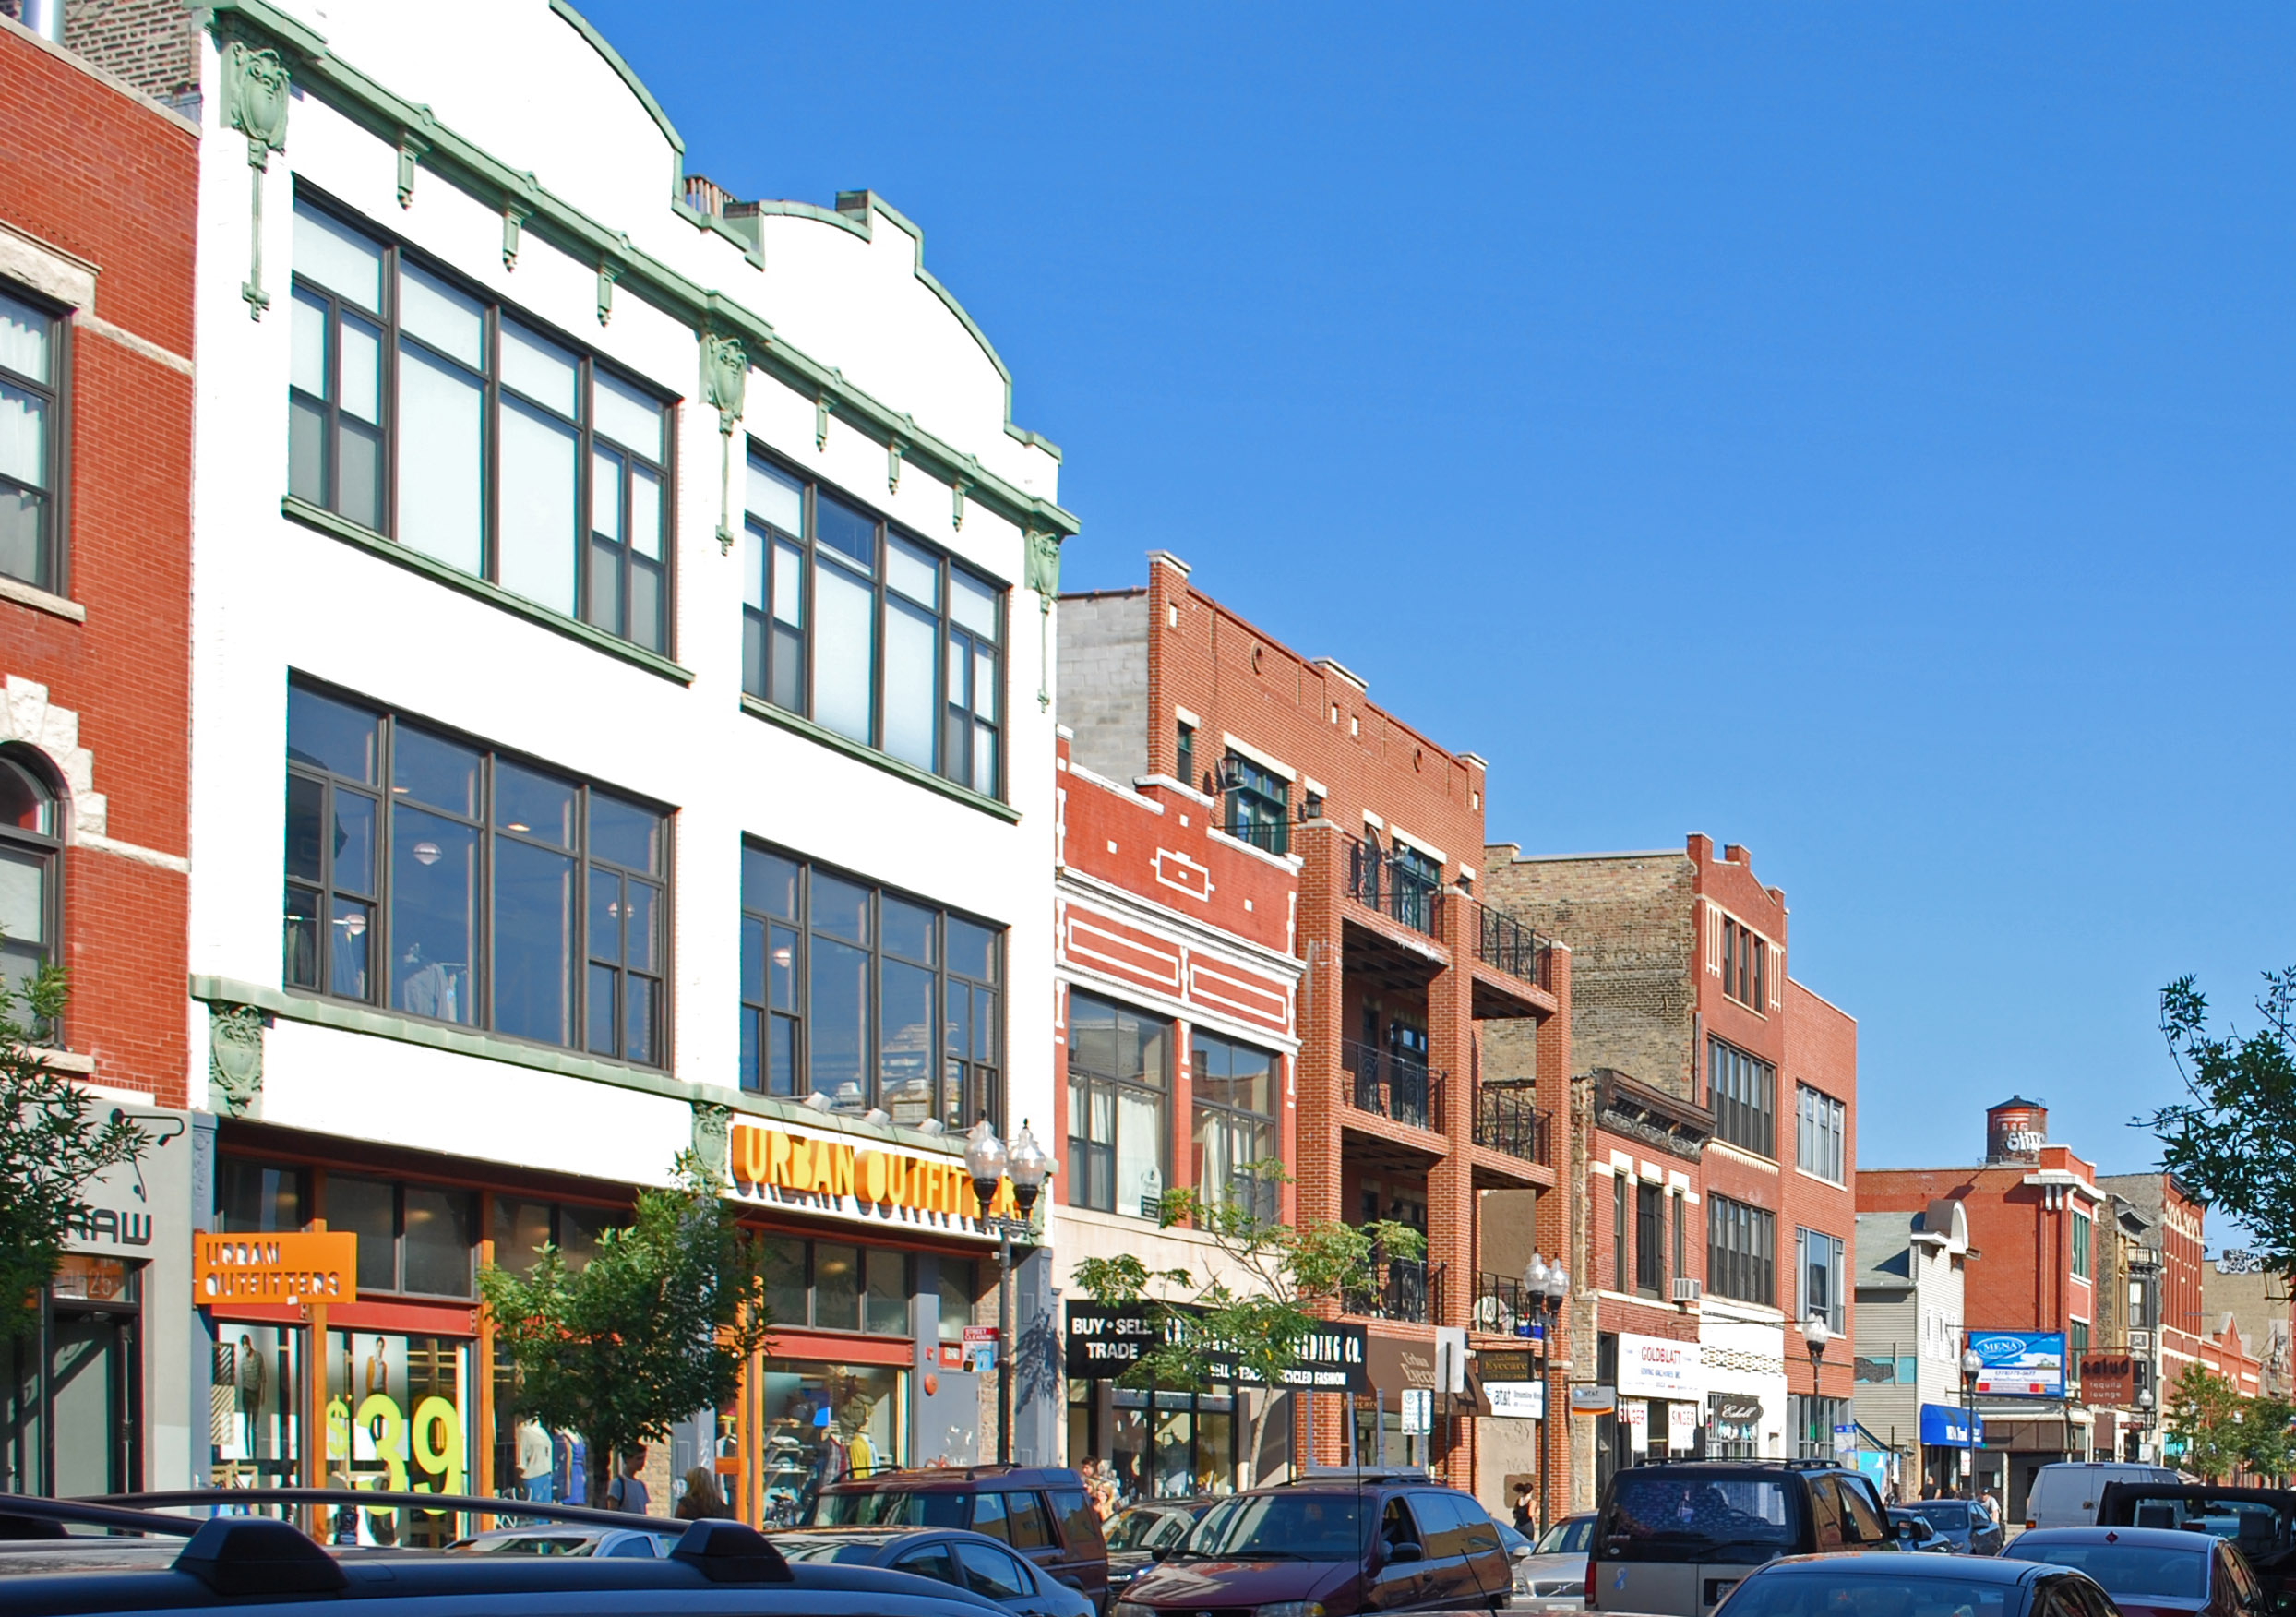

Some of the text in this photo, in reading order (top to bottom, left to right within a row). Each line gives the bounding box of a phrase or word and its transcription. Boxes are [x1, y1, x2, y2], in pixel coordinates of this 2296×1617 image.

[733, 1125, 1034, 1223] URBAN OUTFITR
[63, 1208, 153, 1246] RAW
[206, 1241, 281, 1266] URBAN
[205, 1271, 340, 1296] OUTFITTERS
[1071, 1317, 1153, 1335] BUY SELL
[1085, 1342, 1139, 1359] TRADE
[1287, 1332, 1341, 1362] RADING
[1345, 1336, 1362, 1363] CO.
[1641, 1346, 1681, 1365] GOLDBLATT
[1984, 1341, 2019, 1352] MENA
[1400, 1362, 1436, 1386] Eyeca
[1484, 1360, 1528, 1372] Eyecare
[2082, 1358, 2130, 1376] salud
[1314, 1371, 1347, 1386] FASHION
[2088, 1382, 2123, 1392] tequila
[2088, 1391, 2122, 1400] lounge
[1671, 1410, 1695, 1426] SINGER
[325, 1394, 462, 1516] $39
